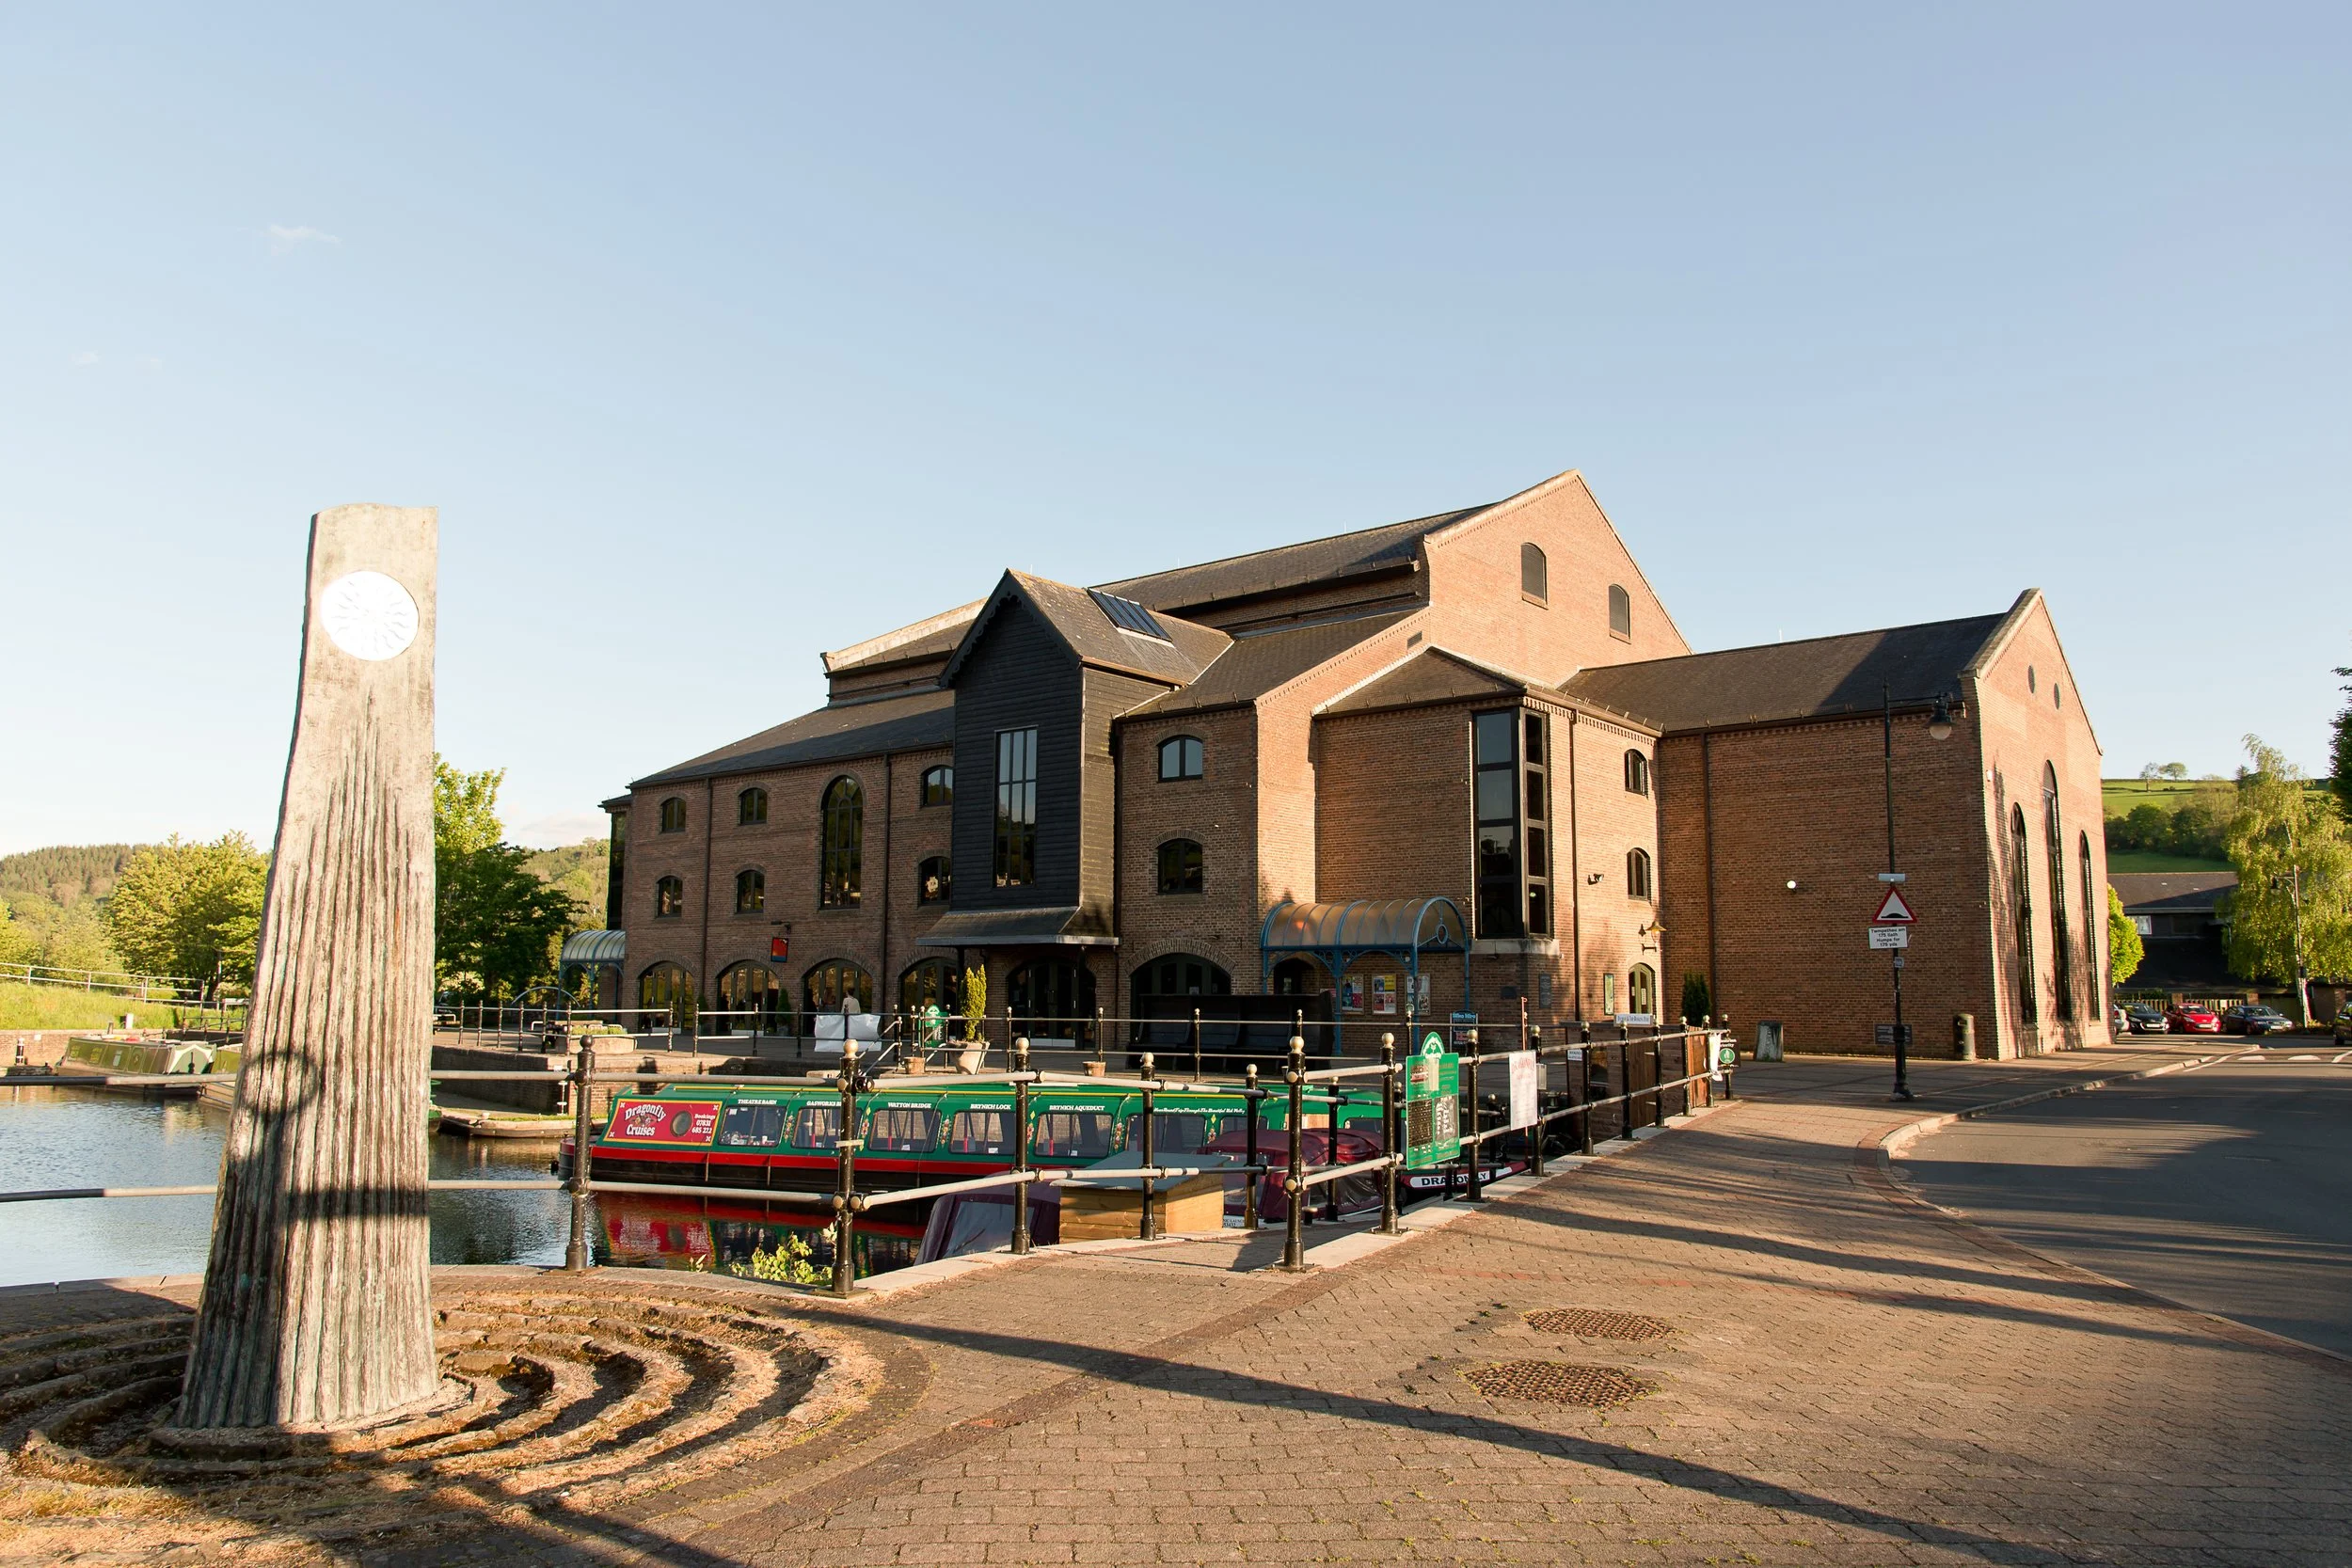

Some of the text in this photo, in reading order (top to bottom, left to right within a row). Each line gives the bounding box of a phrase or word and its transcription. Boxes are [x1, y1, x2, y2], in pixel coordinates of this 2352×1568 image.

[625, 1103, 667, 1122] Dragonfly
[626, 1123, 656, 1136] Cruises
[1421, 1172, 1487, 1186] DRAONLY
